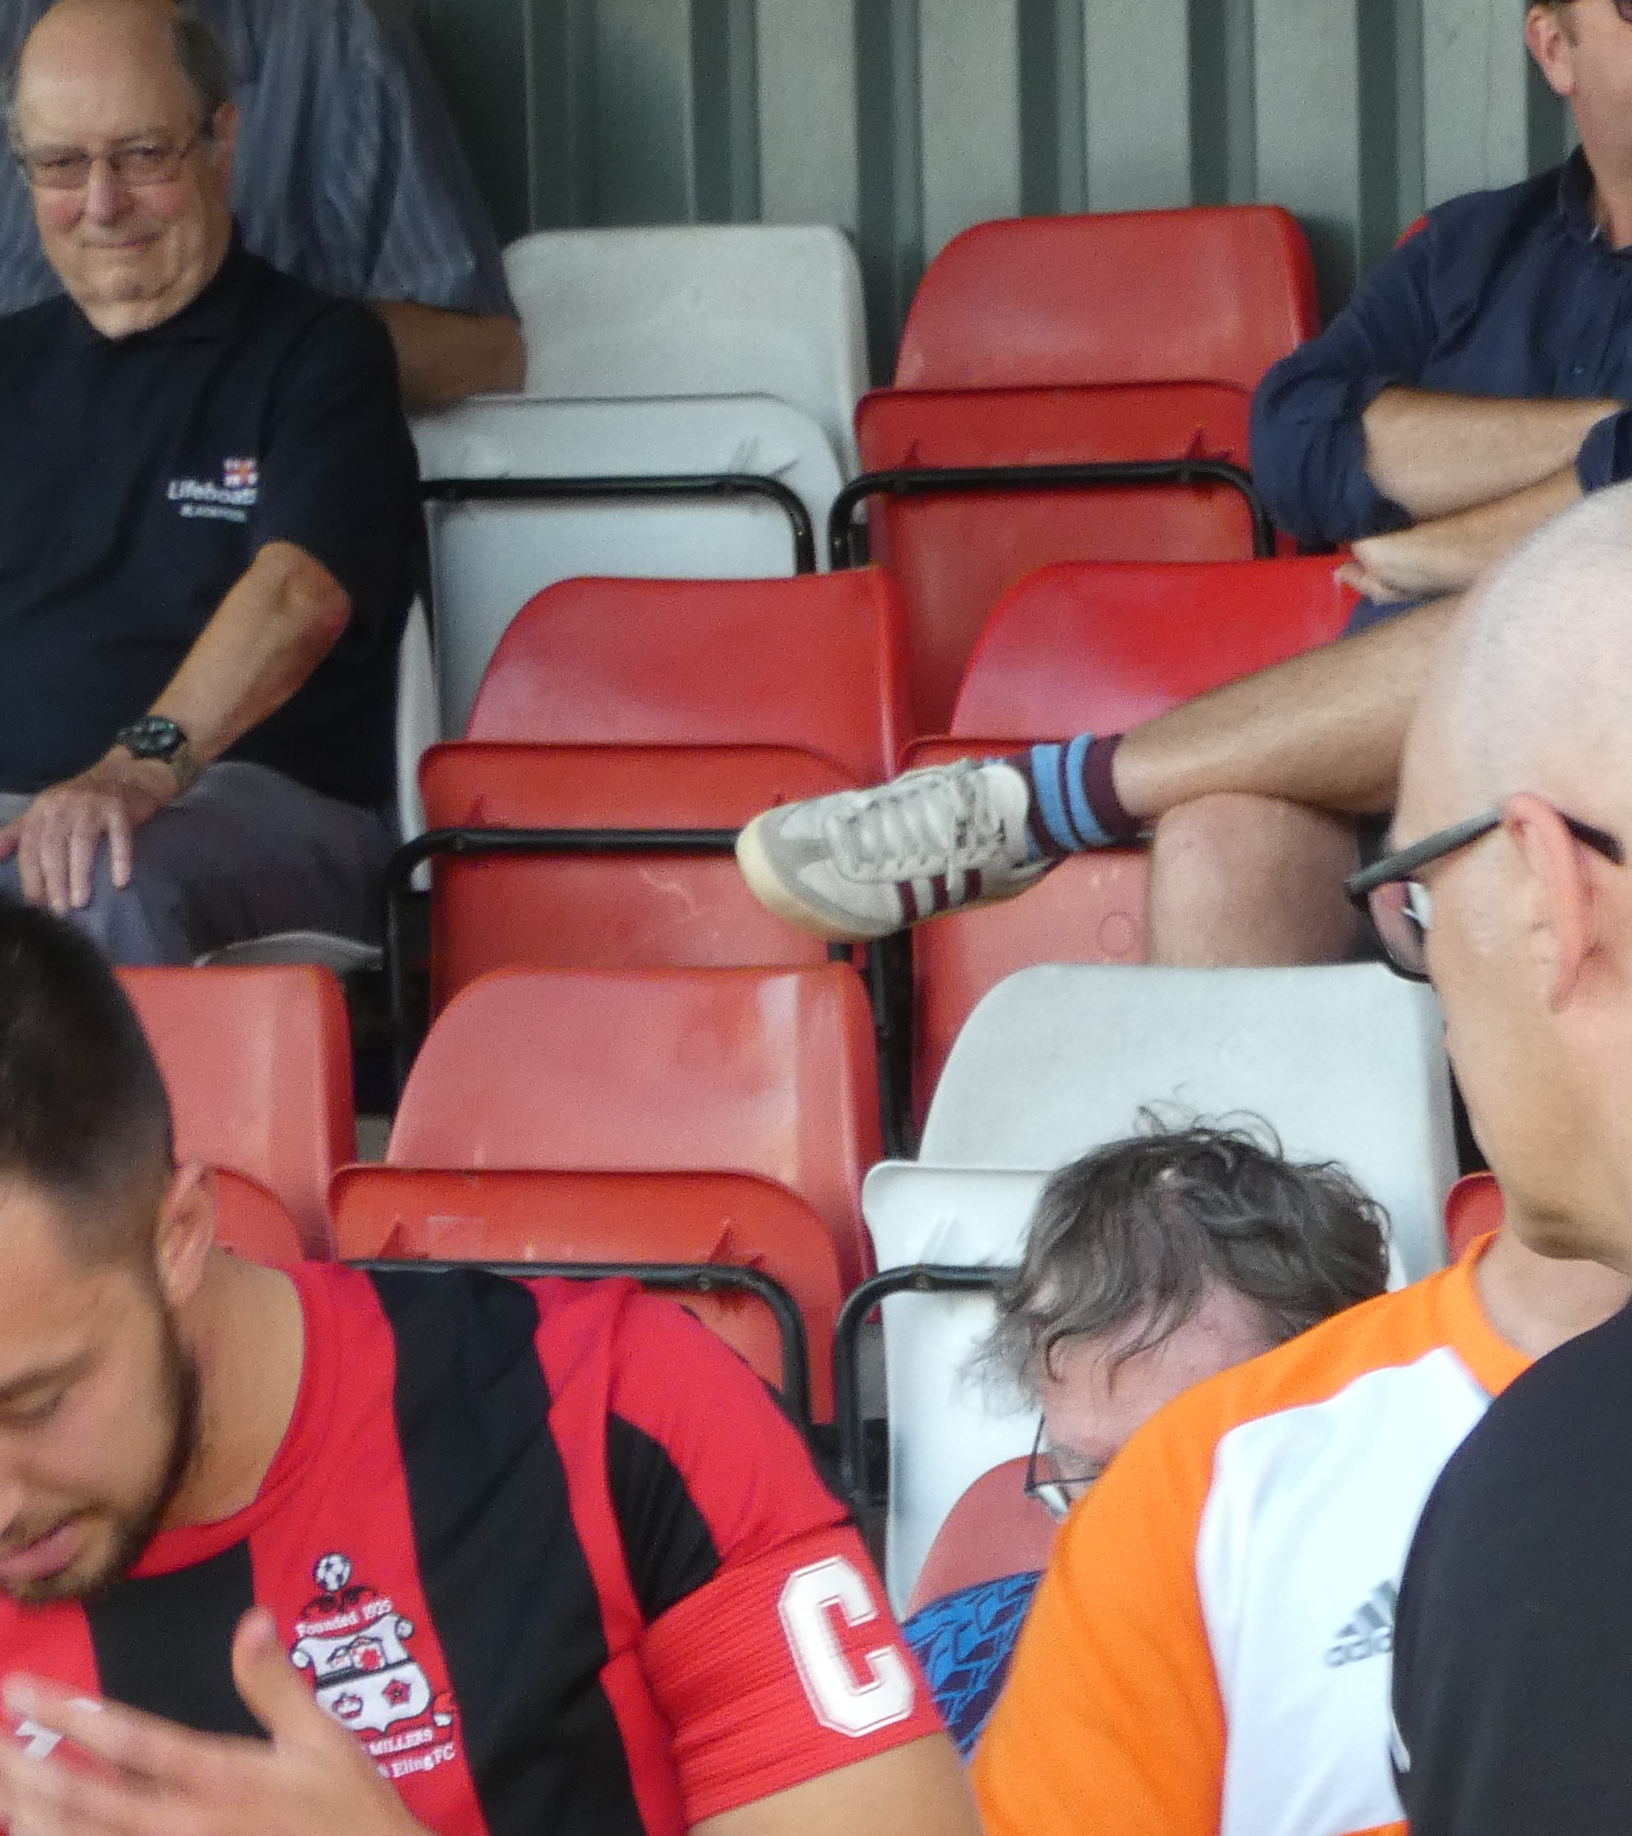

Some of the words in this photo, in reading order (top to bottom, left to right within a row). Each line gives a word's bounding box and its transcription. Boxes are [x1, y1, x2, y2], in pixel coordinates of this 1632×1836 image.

[294, 1610, 360, 1639] Founded
[361, 1597, 393, 1621] 1925
[777, 1553, 917, 1738] C
[368, 1727, 435, 1757] MILLERS
